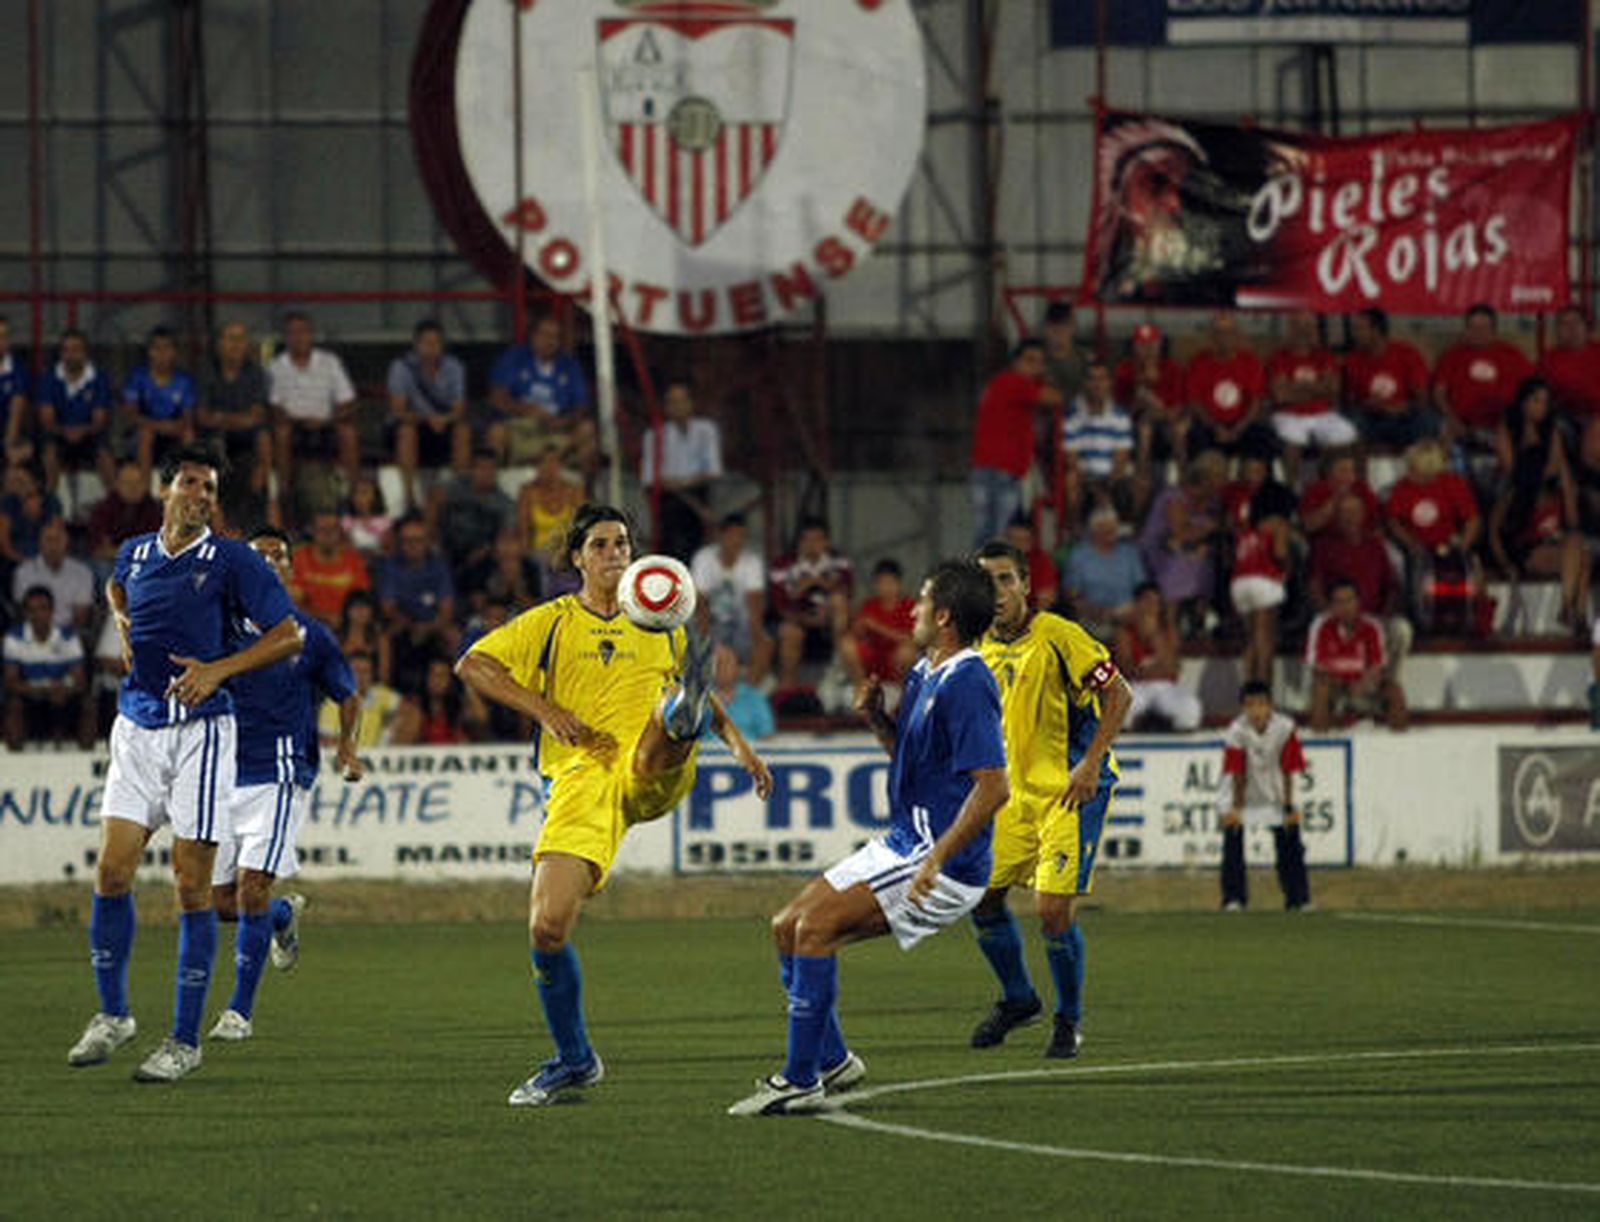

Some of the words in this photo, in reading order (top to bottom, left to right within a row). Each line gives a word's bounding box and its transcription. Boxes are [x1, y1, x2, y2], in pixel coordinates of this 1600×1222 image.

[1247, 150, 1451, 241] Pieles
[1318, 212, 1510, 298] Rojas
[397, 844, 533, 865] MARIS
